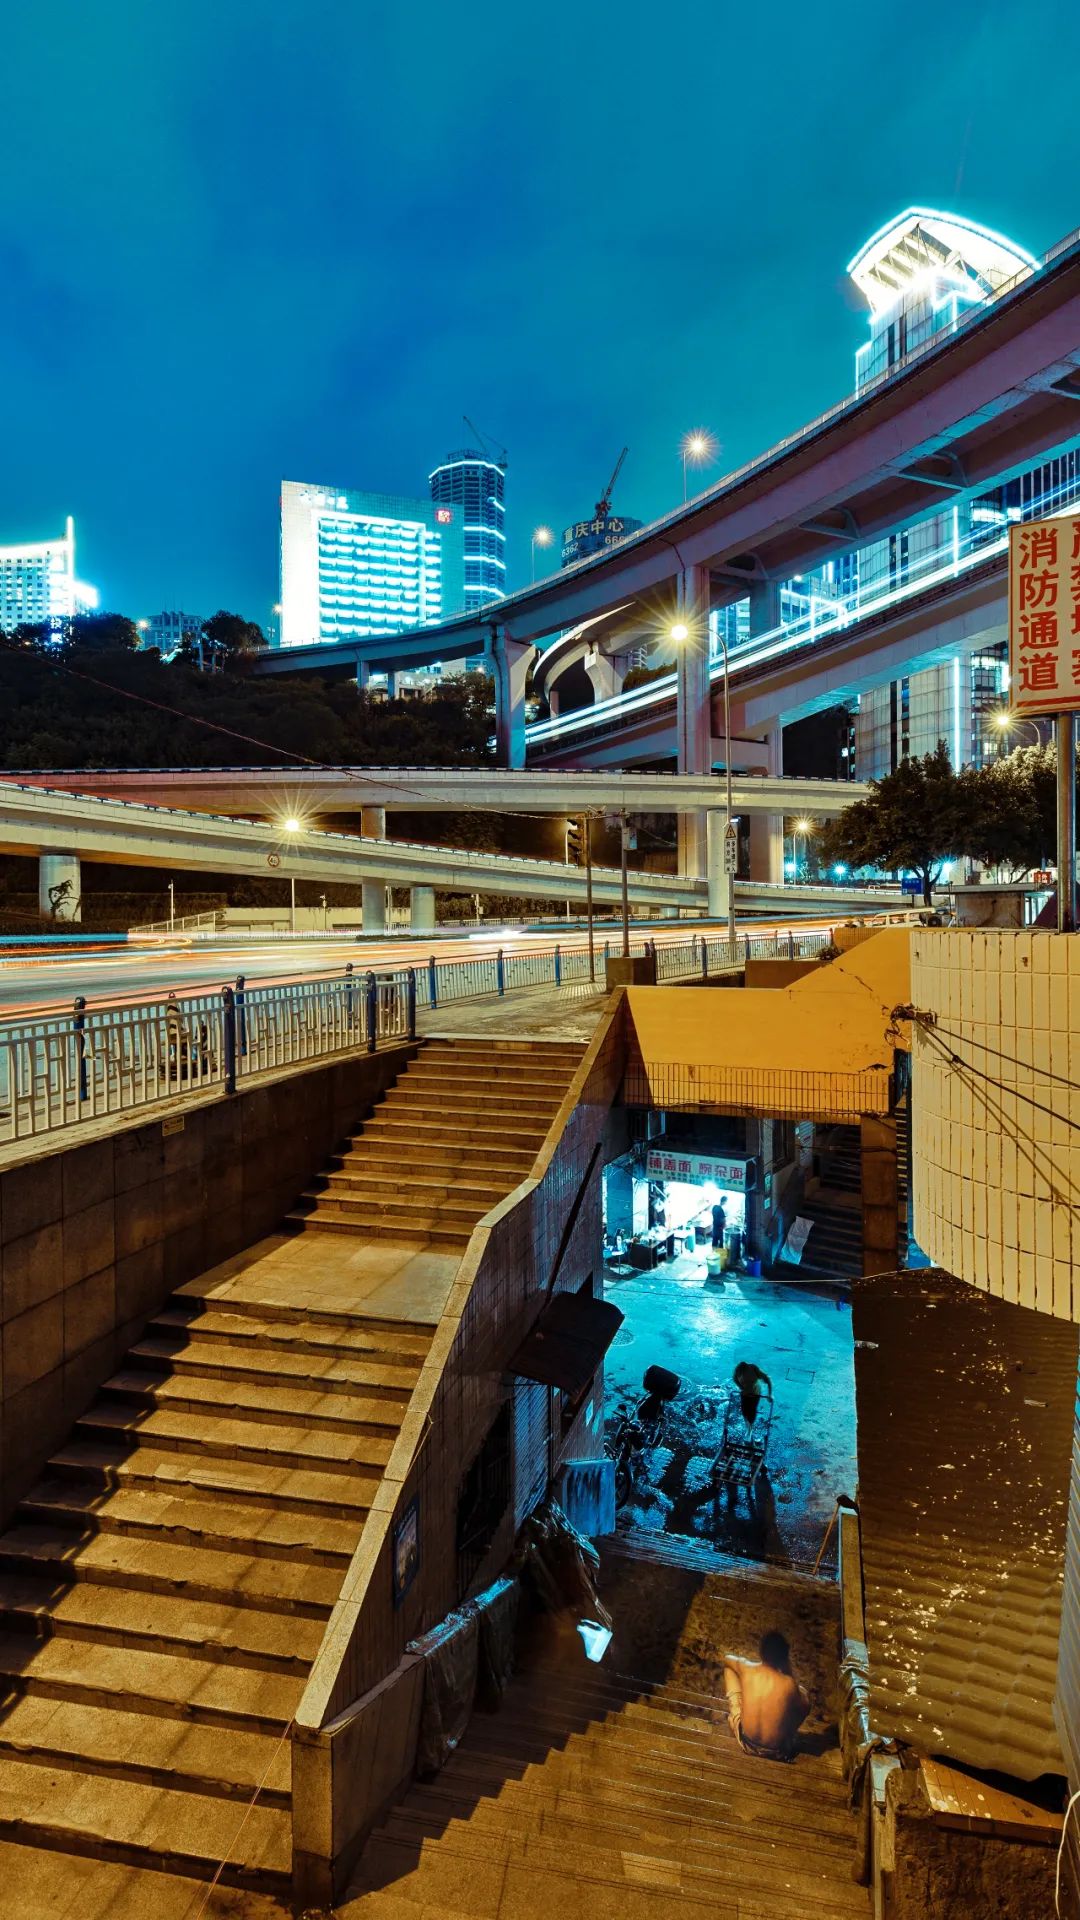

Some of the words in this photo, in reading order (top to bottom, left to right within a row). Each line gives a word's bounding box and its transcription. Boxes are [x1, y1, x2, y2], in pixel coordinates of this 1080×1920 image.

[565, 518, 624, 544] 重庆中心
[1018, 527, 1059, 692] 消防通道
